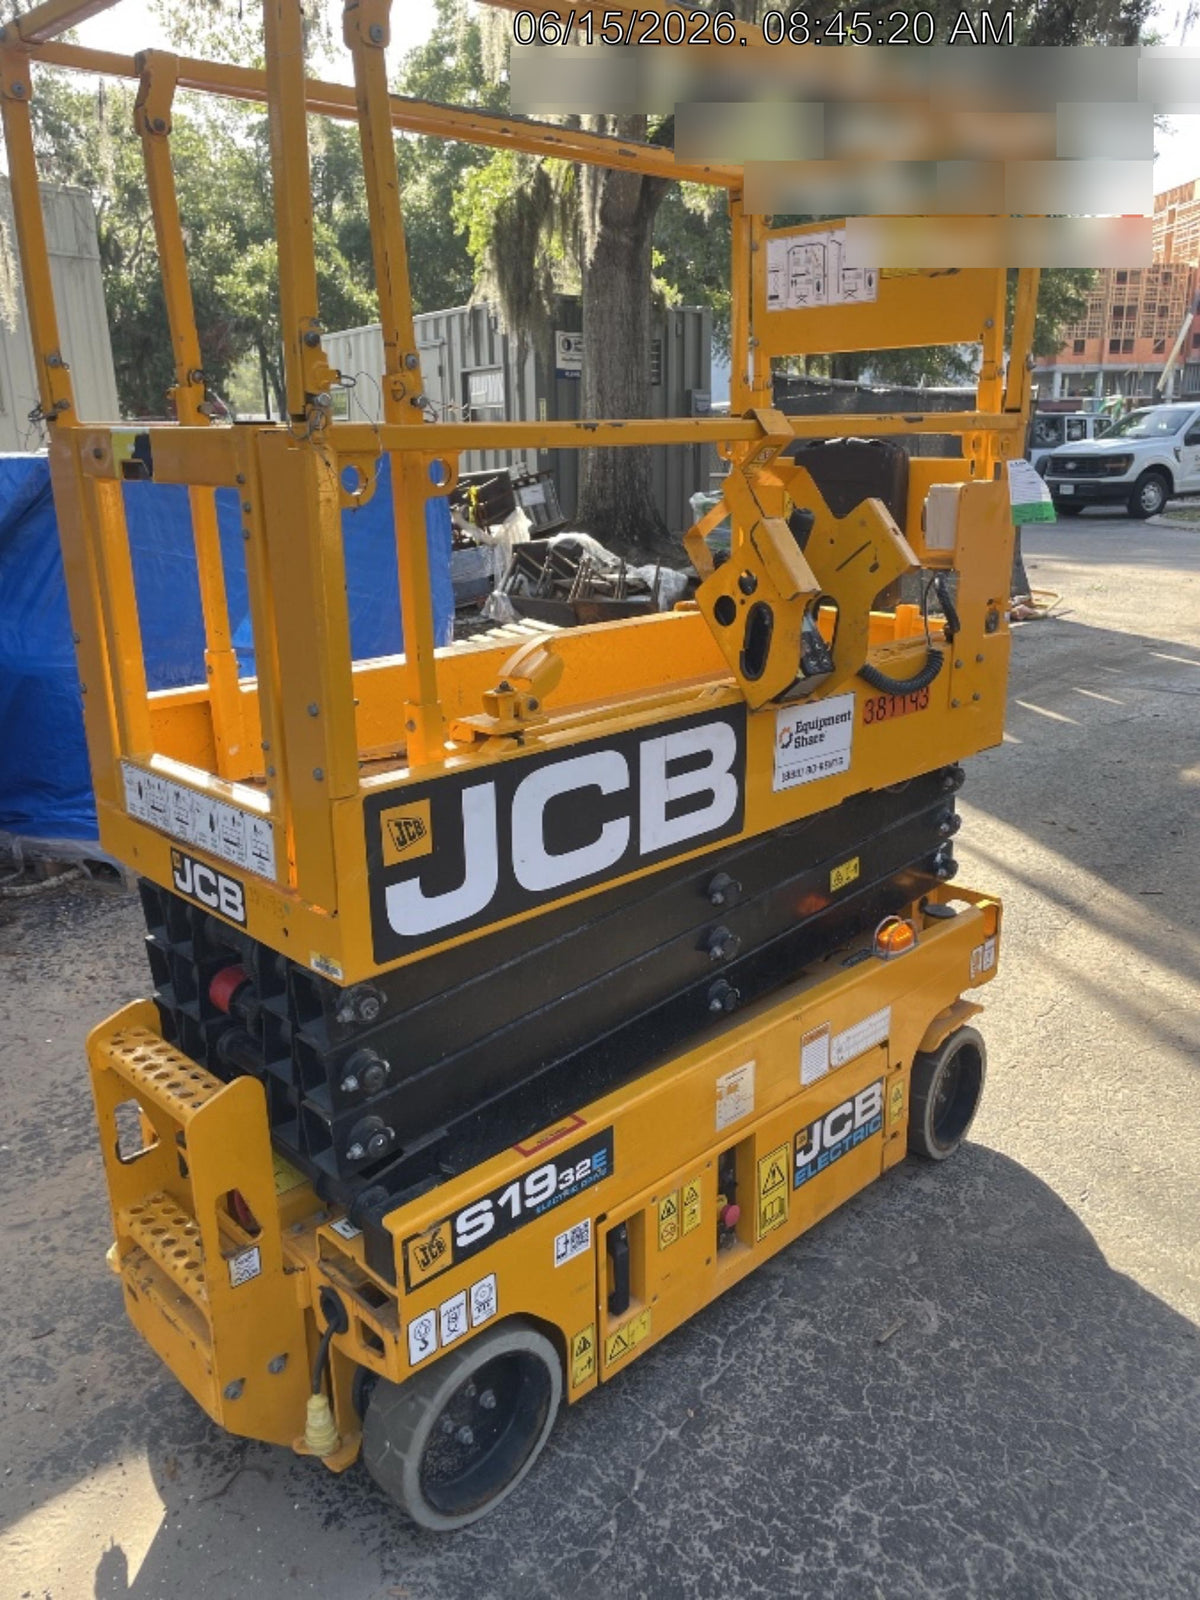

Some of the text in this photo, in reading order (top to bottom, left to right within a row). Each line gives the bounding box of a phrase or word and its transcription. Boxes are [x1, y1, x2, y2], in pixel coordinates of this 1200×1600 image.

[794, 709, 852, 735] Equipment
[794, 732, 826, 750] Share
[385, 721, 738, 936] JCB
[394, 817, 425, 845] JCB
[174, 857, 246, 922] JCB
[795, 1082, 882, 1167] JCB
[795, 1114, 883, 1188] ELECTRIC
